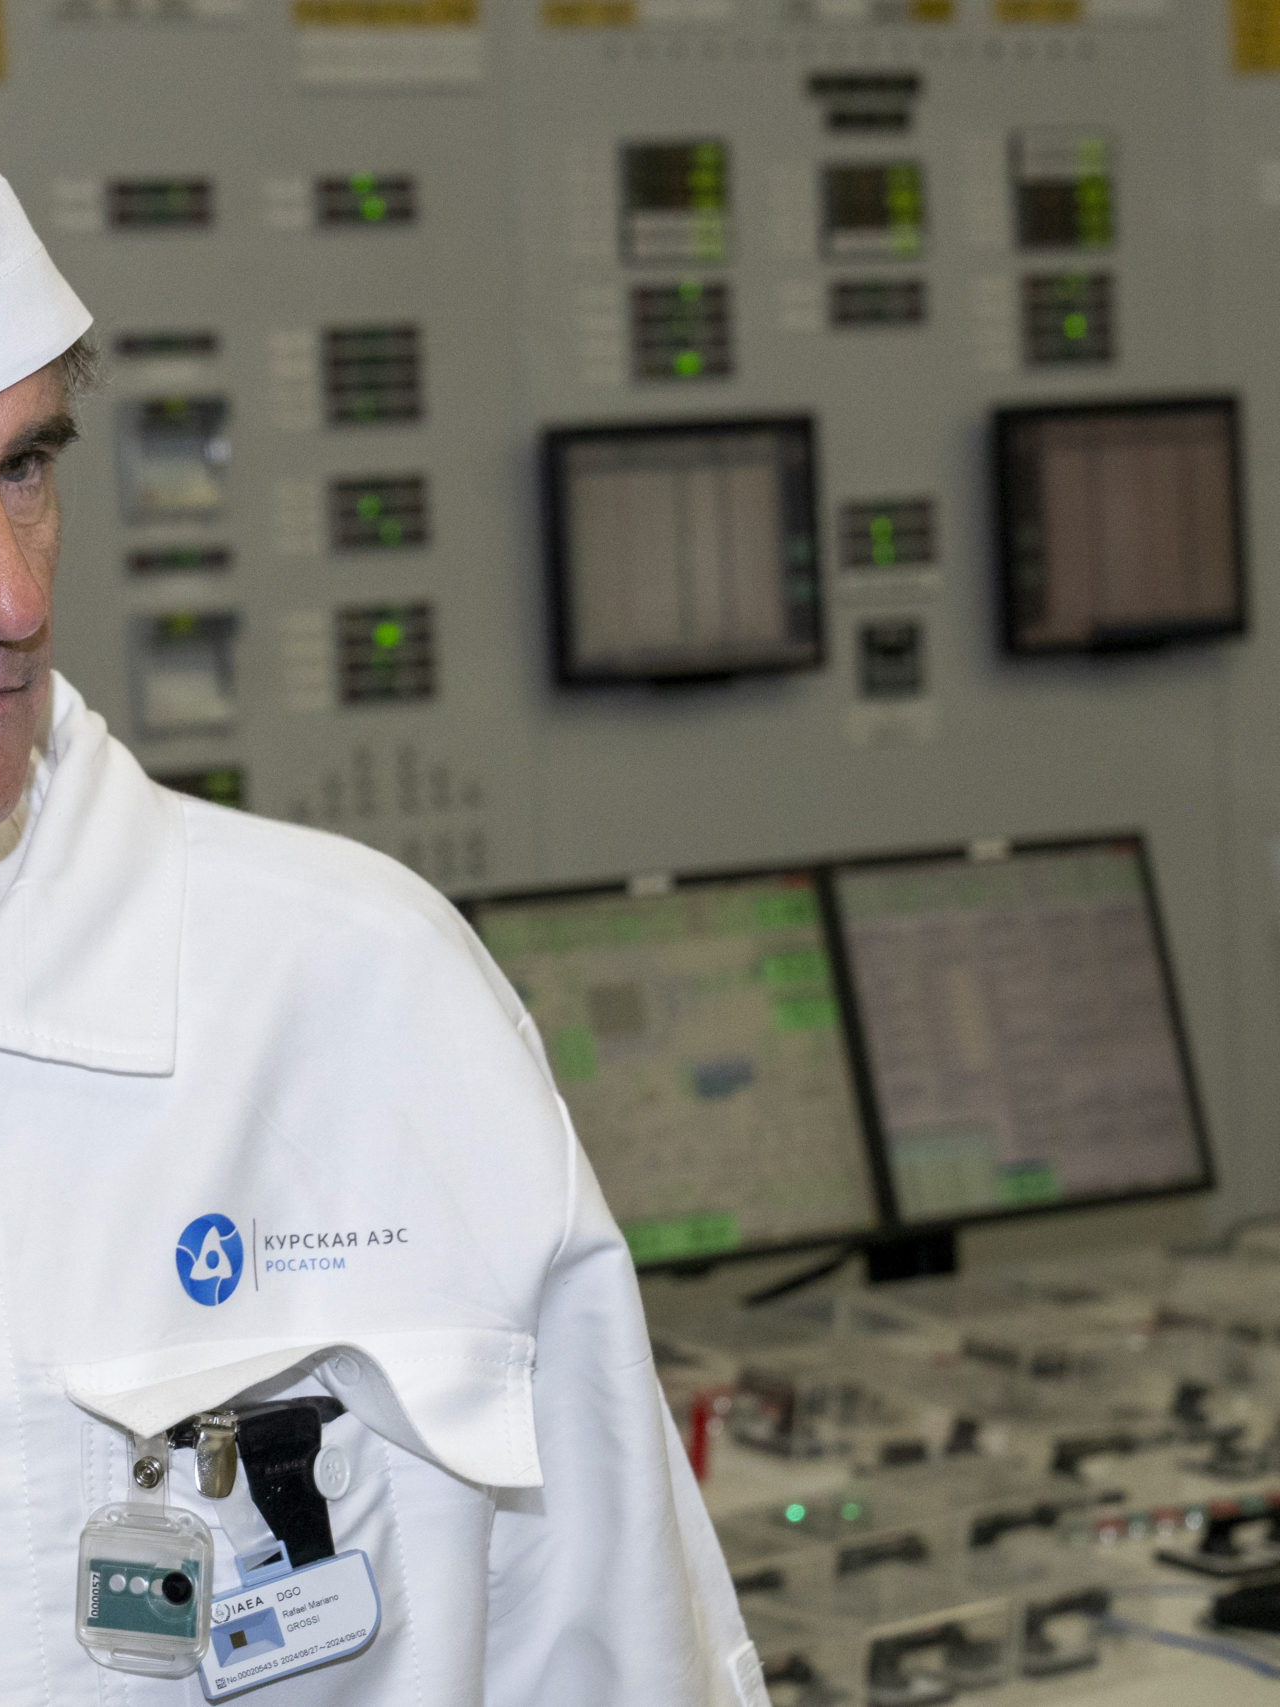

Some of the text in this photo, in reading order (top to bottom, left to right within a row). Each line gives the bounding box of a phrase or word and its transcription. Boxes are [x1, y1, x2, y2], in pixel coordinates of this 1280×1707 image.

[264, 1228, 409, 1251] КУРСКАЯ АЭС
[265, 1257, 346, 1272] РОСАТОМ
[276, 1586, 301, 1602] DGO
[232, 1596, 264, 1615] IAEA
[282, 1594, 339, 1618] Rafael Mariano
[287, 1615, 320, 1632] GROSSI
